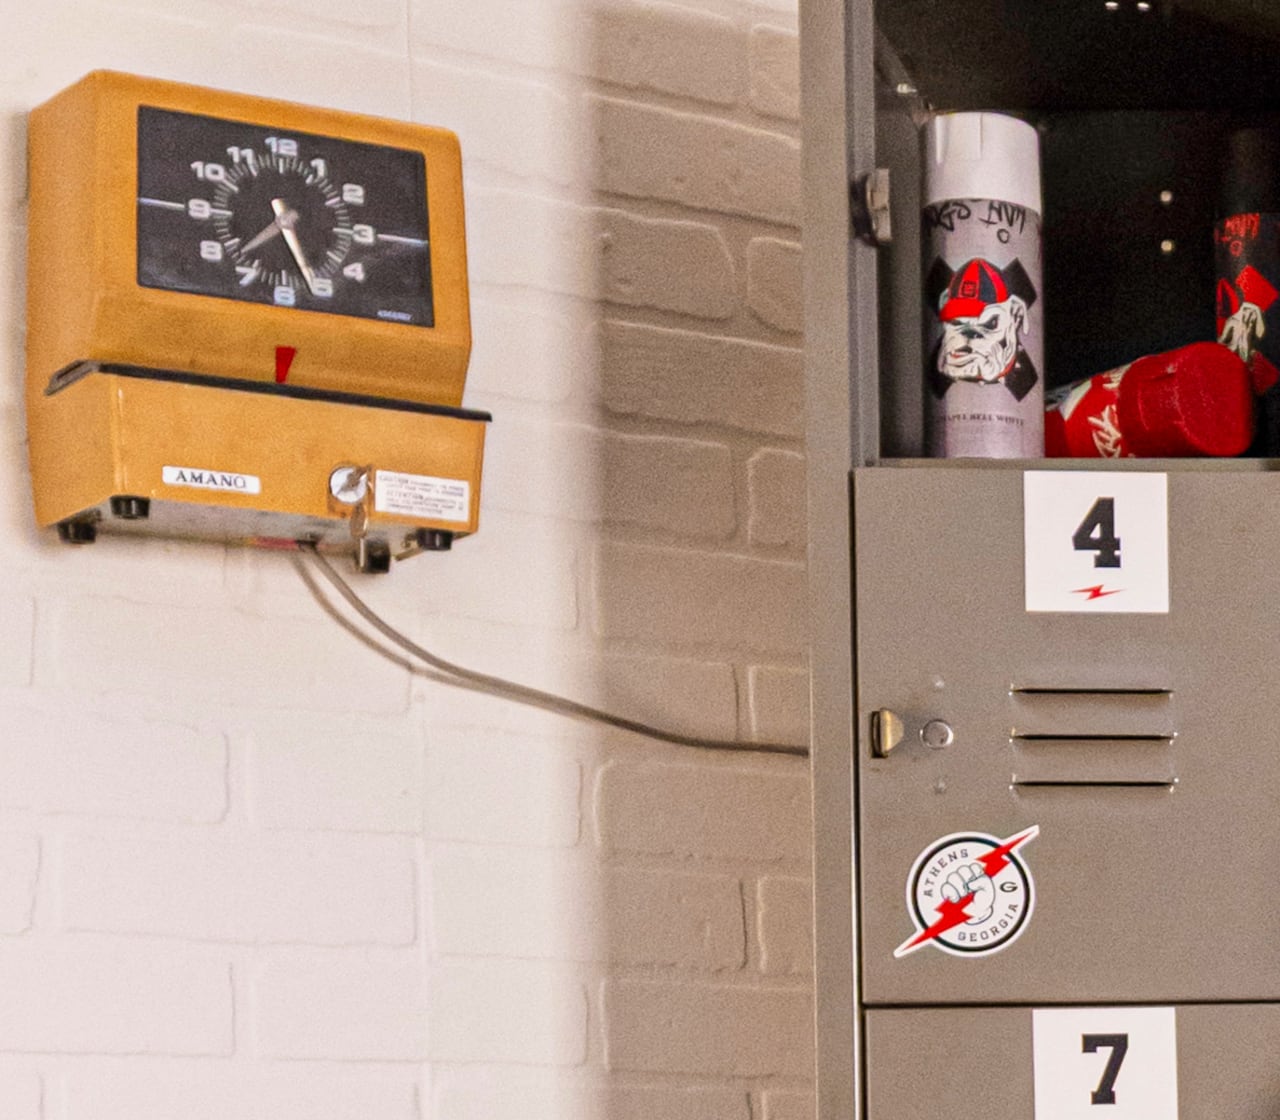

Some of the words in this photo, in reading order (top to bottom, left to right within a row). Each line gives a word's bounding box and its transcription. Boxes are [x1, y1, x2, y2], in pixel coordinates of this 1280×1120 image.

[227, 146, 256, 166] 11
[264, 136, 299, 157] 12
[190, 161, 226, 181] 10
[311, 158, 326, 178] 1
[188, 198, 211, 220] 9
[352, 224, 375, 244] 3
[200, 240, 223, 262] 8
[343, 262, 365, 282] 4
[175, 470, 247, 489] AMANO
[1072, 497, 1122, 568] 4
[923, 848, 969, 898] ATHENS
[999, 881, 1018, 893] G
[957, 903, 1018, 942] GEORGIA
[1082, 1034, 1129, 1105] 7
